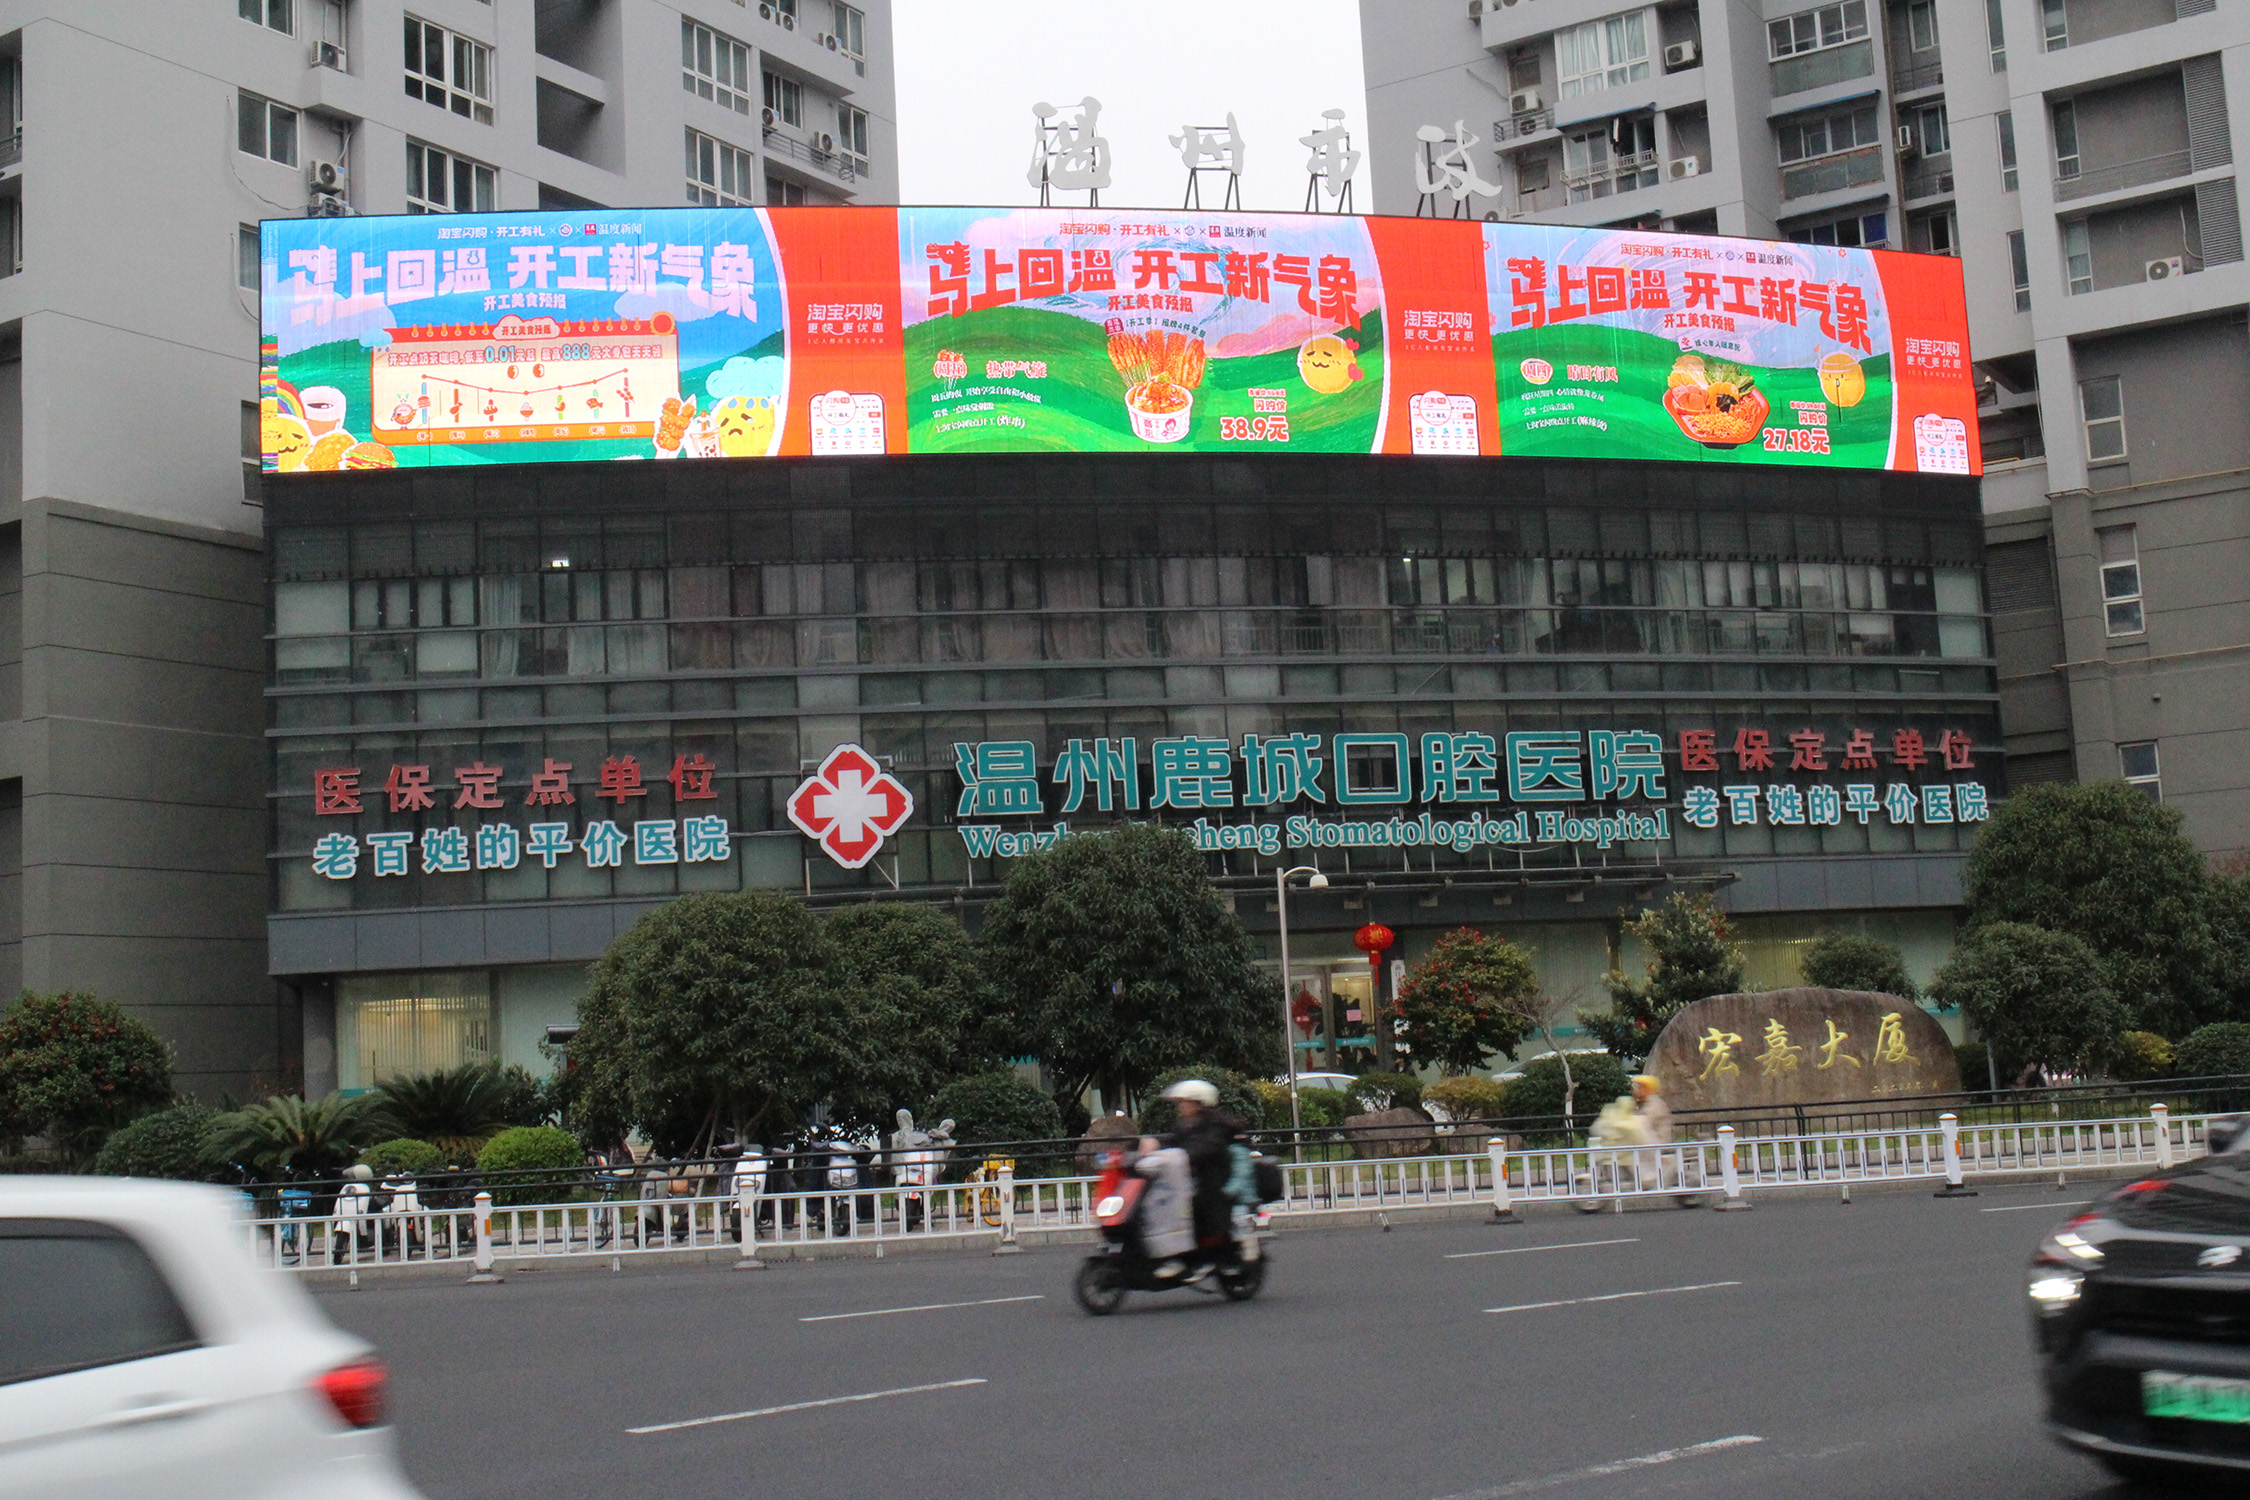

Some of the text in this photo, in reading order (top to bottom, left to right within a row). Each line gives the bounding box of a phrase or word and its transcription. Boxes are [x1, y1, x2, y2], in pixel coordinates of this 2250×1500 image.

[507, 241, 757, 323] 开工新气象
[1132, 249, 1361, 331] 开工新气象
[484, 292, 566, 311] 开工美食预报
[807, 303, 883, 321] 淘宝闪购
[1107, 294, 1193, 312] 开工美食预报
[1404, 310, 1472, 328] 淘宝闪购
[1683, 271, 1872, 356] 开工新气象
[1664, 313, 1735, 332] 开工美食预报
[1906, 338, 1960, 357] 淘宝闪购
[1254, 398, 1287, 413] 闪购价
[1798, 411, 1828, 426] 闪购价
[1220, 415, 1290, 441] 38.9元
[1762, 427, 1831, 454] 27.18元
[1679, 727, 1975, 771] 医保定点单位
[314, 753, 718, 815] 医保定点单位
[953, 731, 1667, 817] 温州鹿城口腔医院
[1683, 781, 1989, 828] 老百姓的平价医院
[313, 814, 731, 879] 老百姓的平价医院
[1286, 811, 1531, 853] Stomatological
[1535, 808, 1671, 849] Hospital
[1698, 1012, 1921, 1080] 宏嘉大厦
